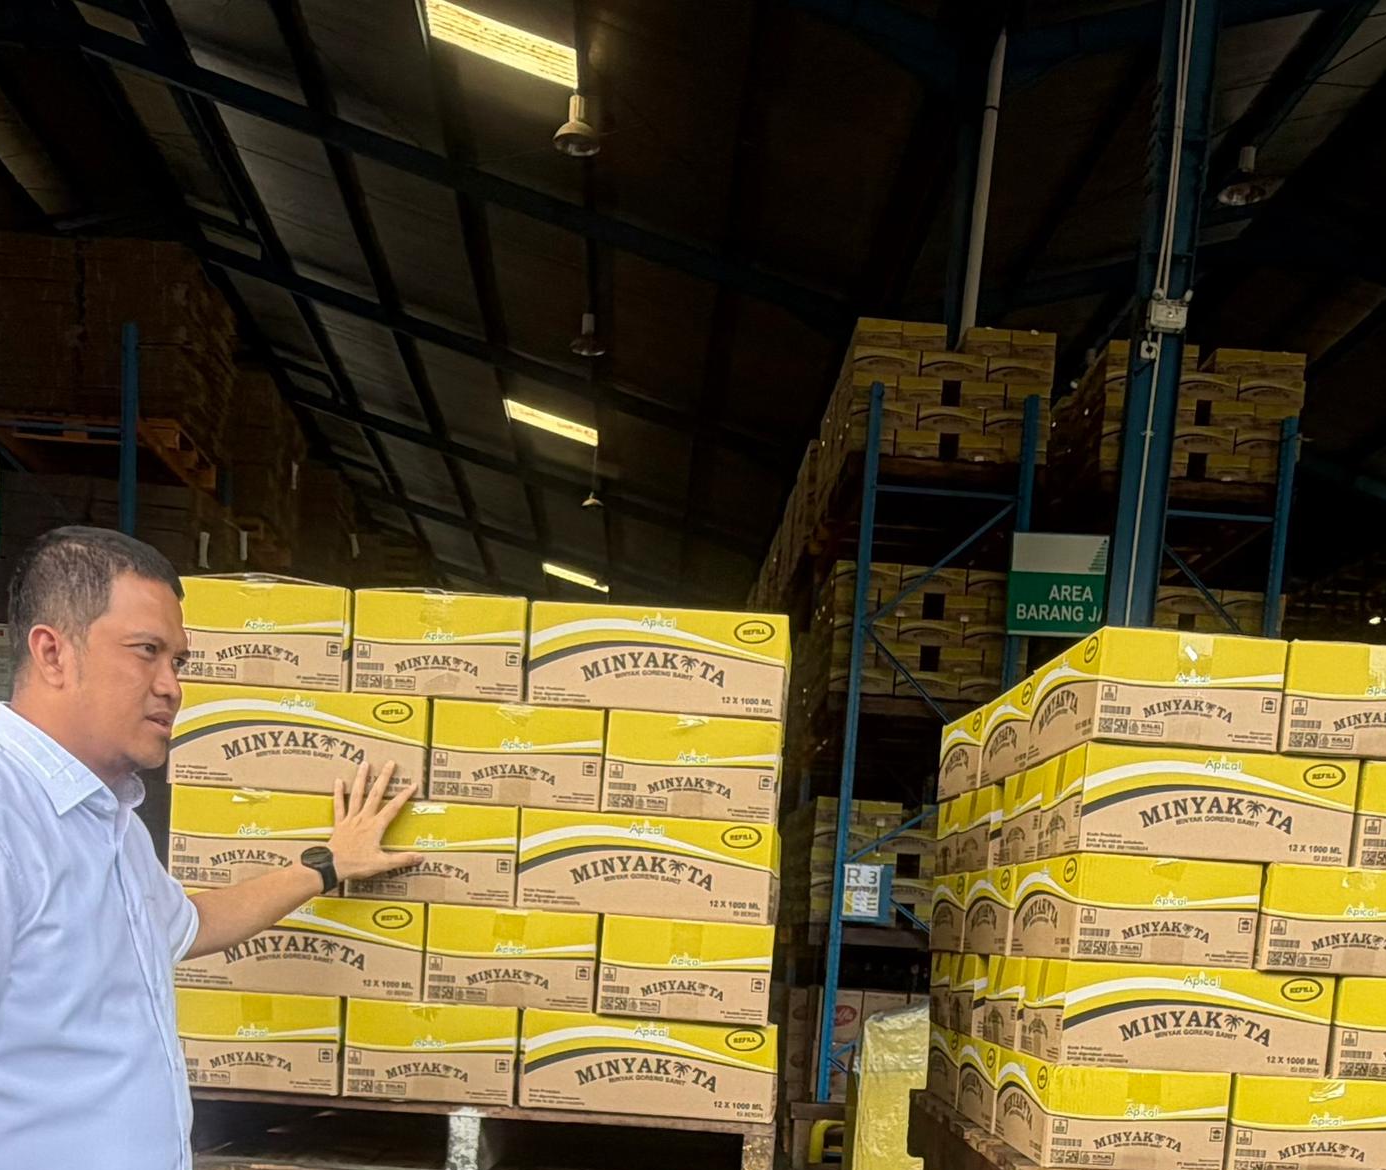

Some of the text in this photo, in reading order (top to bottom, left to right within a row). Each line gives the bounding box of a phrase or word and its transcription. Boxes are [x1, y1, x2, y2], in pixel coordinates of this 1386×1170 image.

[1049, 584, 1093, 602] AREA
[1016, 603, 1084, 622] BARANG
[743, 628, 766, 636] REFILL
[381, 708, 404, 716] REFILL
[1312, 772, 1337, 780] REFILL
[730, 833, 753, 841] REFILL
[381, 914, 404, 922] REFILL
[1289, 985, 1314, 994] REFILL
[733, 1036, 756, 1044] REFILL
